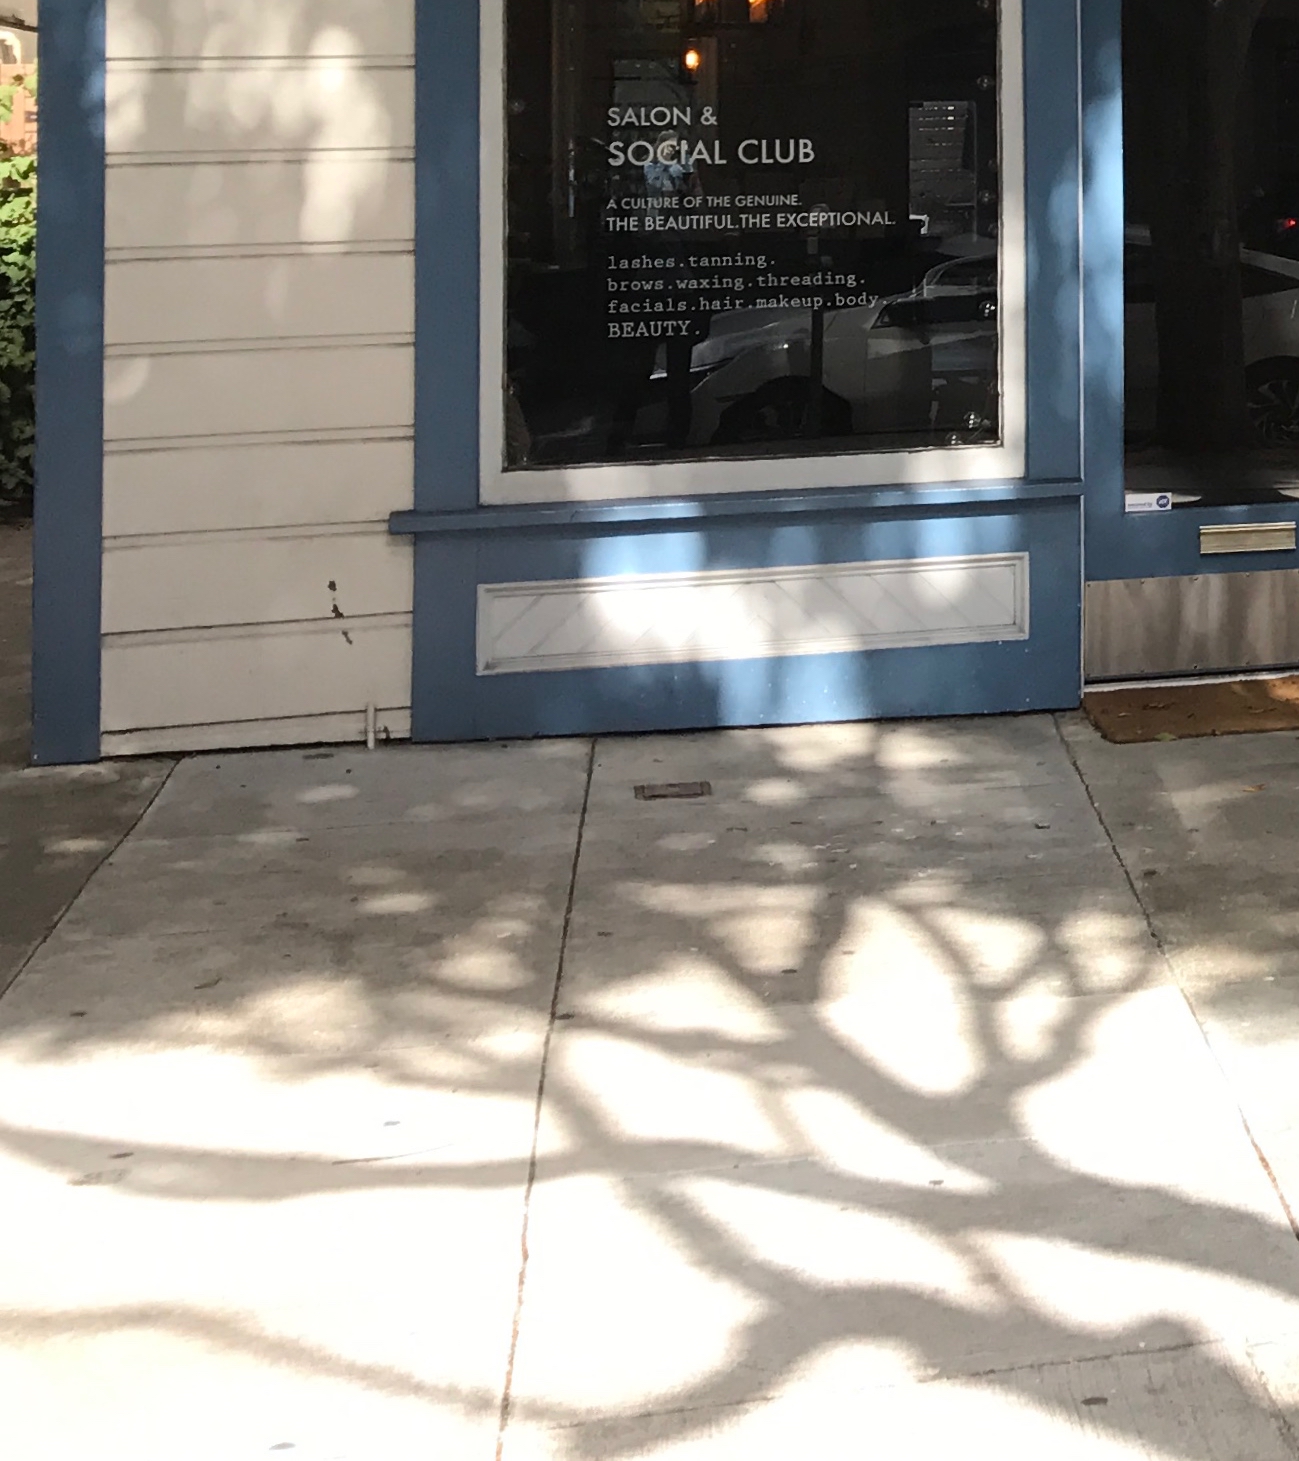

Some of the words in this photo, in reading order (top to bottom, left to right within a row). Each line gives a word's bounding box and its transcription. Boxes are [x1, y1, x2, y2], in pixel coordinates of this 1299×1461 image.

[607, 106, 691, 126] SALON
[700, 106, 718, 126] &
[607, 139, 727, 166] SOCIAL
[737, 138, 815, 164] CLUB
[606, 199, 617, 210] A
[621, 196, 680, 210] CULTURE
[683, 195, 703, 209] OF
[706, 196, 731, 208] THE
[734, 193, 802, 208] GENUINE.
[606, 216, 639, 231] THE
[776, 211, 896, 228] EXCEPTIONAL.
[607, 253, 776, 270] lashes.tanning.
[607, 273, 865, 290] brows.waxing.threading.
[607, 320, 701, 338] BEAUTY.
